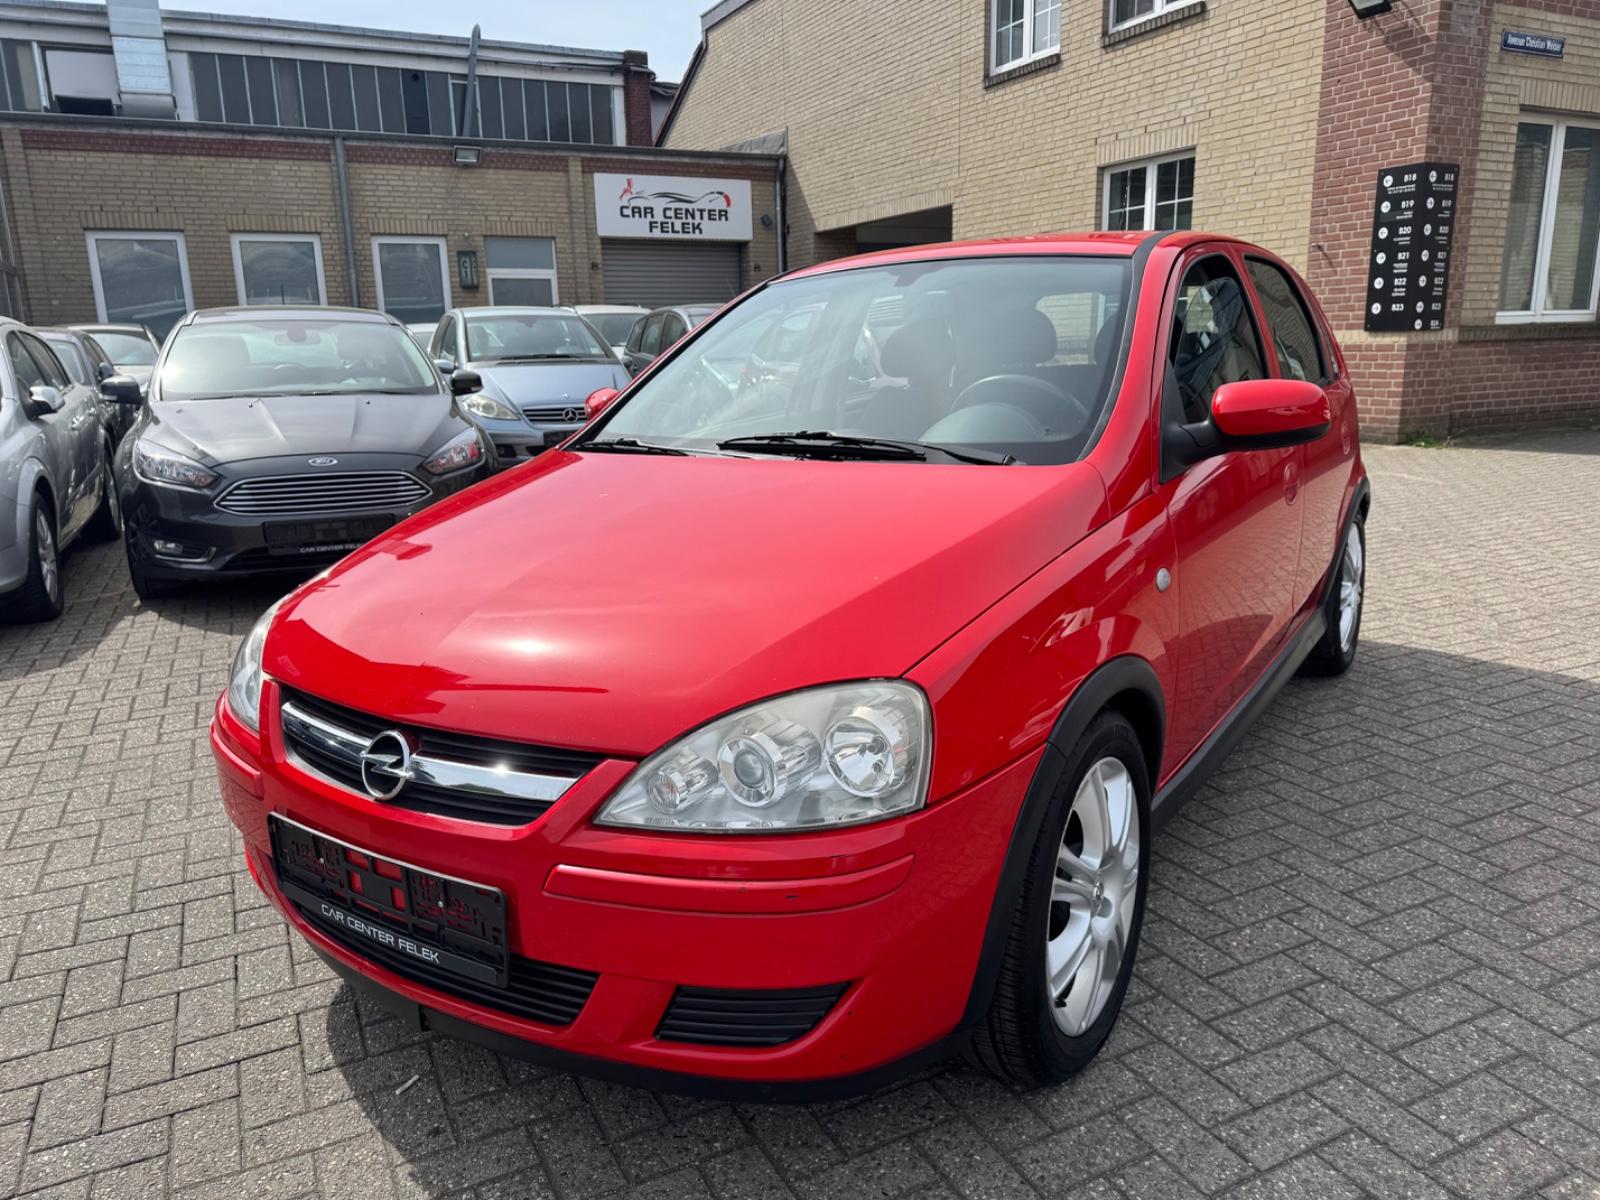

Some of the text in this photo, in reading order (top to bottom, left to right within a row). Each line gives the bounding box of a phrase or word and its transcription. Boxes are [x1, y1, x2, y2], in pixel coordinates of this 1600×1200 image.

[619, 205, 729, 222] CAR CENTER
[649, 220, 703, 235] FELEK
[321, 903, 441, 964] CAR CENTER FELEK
